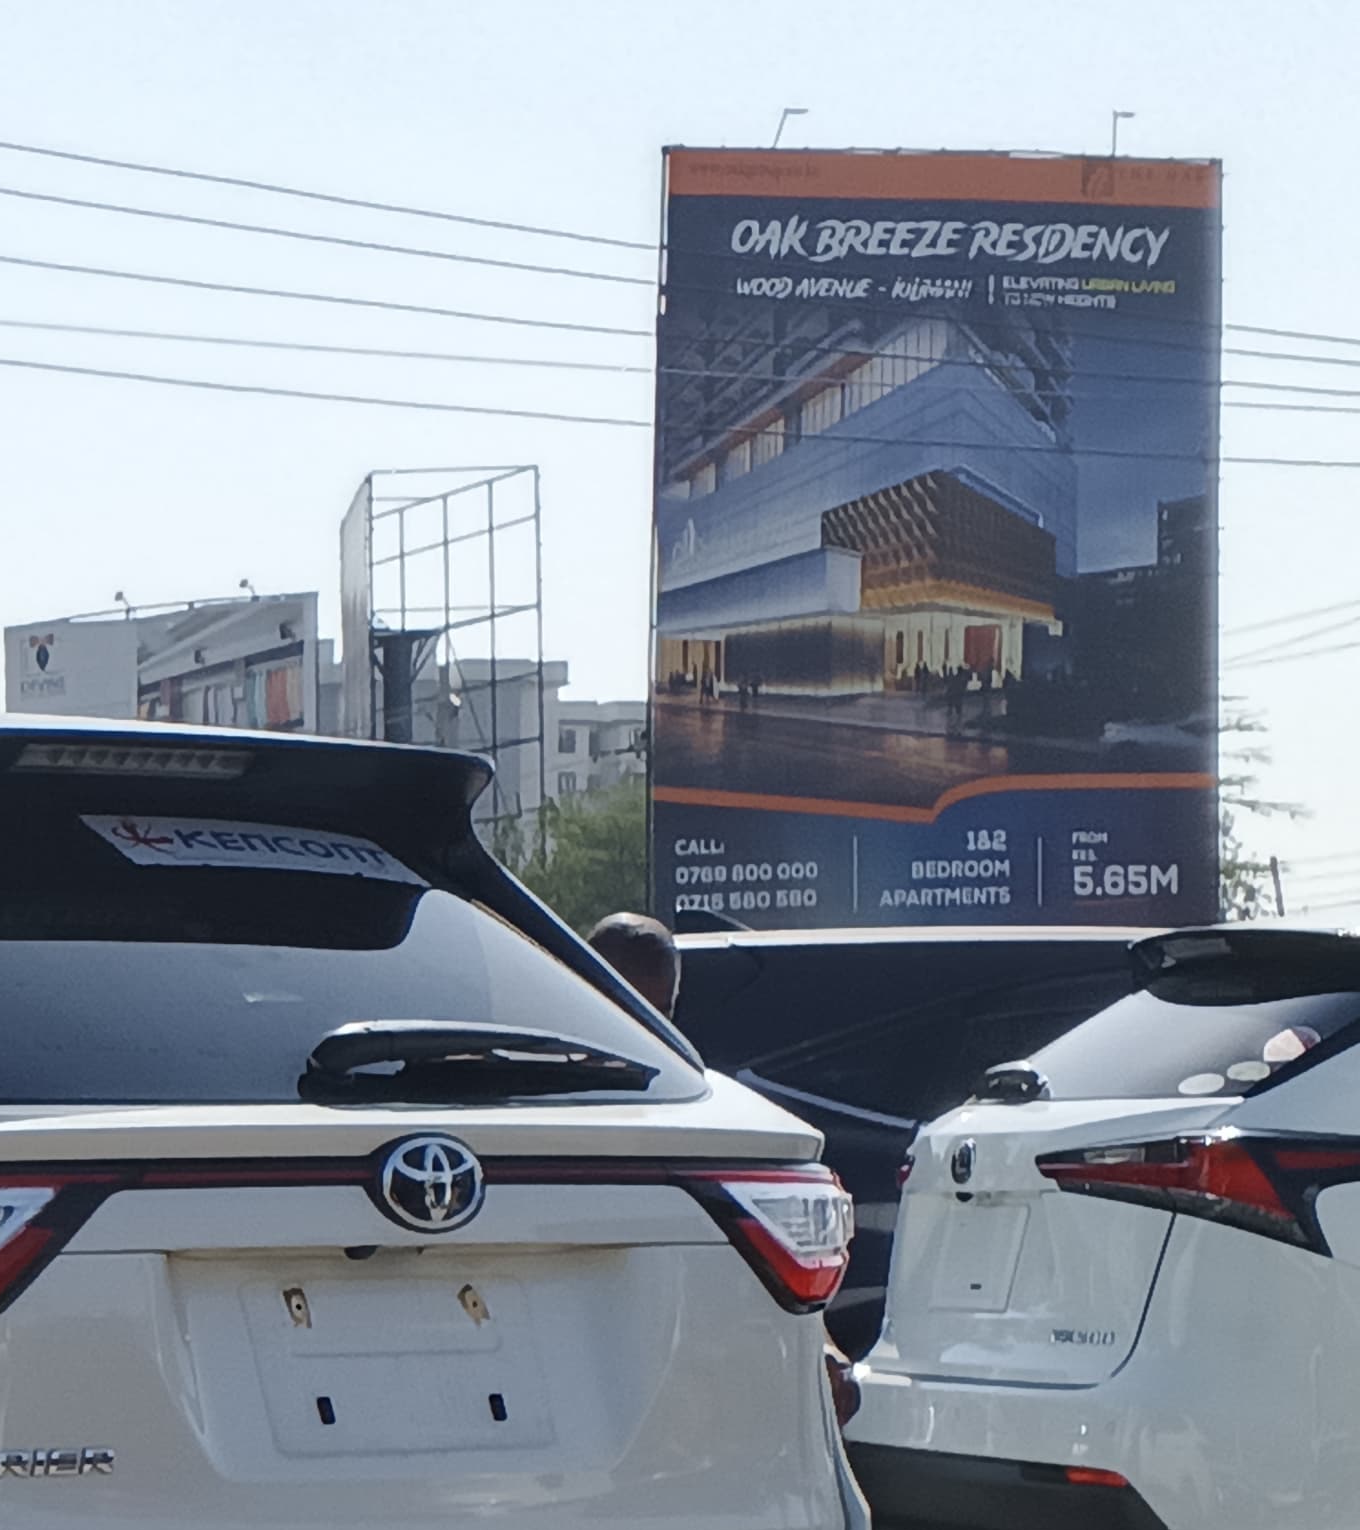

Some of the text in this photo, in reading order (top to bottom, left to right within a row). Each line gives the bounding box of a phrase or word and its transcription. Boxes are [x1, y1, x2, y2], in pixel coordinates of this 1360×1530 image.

[732, 215, 1170, 269] OAK BREEZE RESIDENCY
[736, 277, 793, 299] WOOD
[795, 277, 873, 299] AVENUE
[911, 859, 1011, 879] BEDROOM
[1073, 863, 1179, 896] 5.65M
[880, 886, 1011, 907] APARTMENTS
